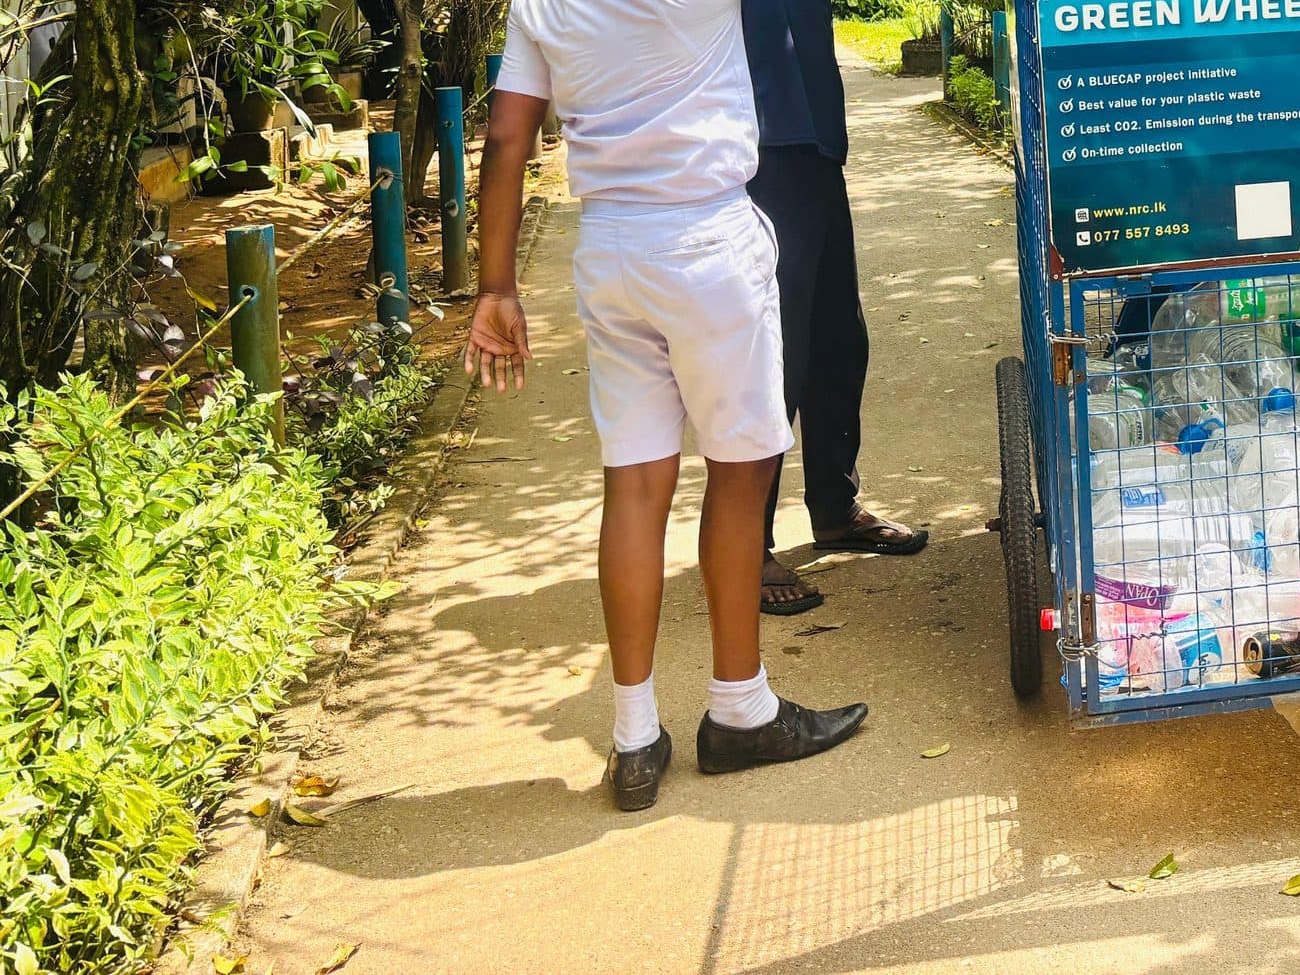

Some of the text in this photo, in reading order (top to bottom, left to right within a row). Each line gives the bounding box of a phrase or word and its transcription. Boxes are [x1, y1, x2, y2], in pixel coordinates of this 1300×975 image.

[1077, 67, 1237, 87] A BLUECAP project initiative
[1079, 89, 1261, 111] Best value for your plastic waste
[1080, 123, 1110, 135] Least
[1145, 117, 1195, 130] Emission
[1198, 115, 1233, 126] during
[1236, 112, 1254, 123] the
[1081, 141, 1183, 158] On-time collection
[1093, 201, 1167, 218] www.nrc.lk
[1094, 223, 1190, 243] 077 557 8493
